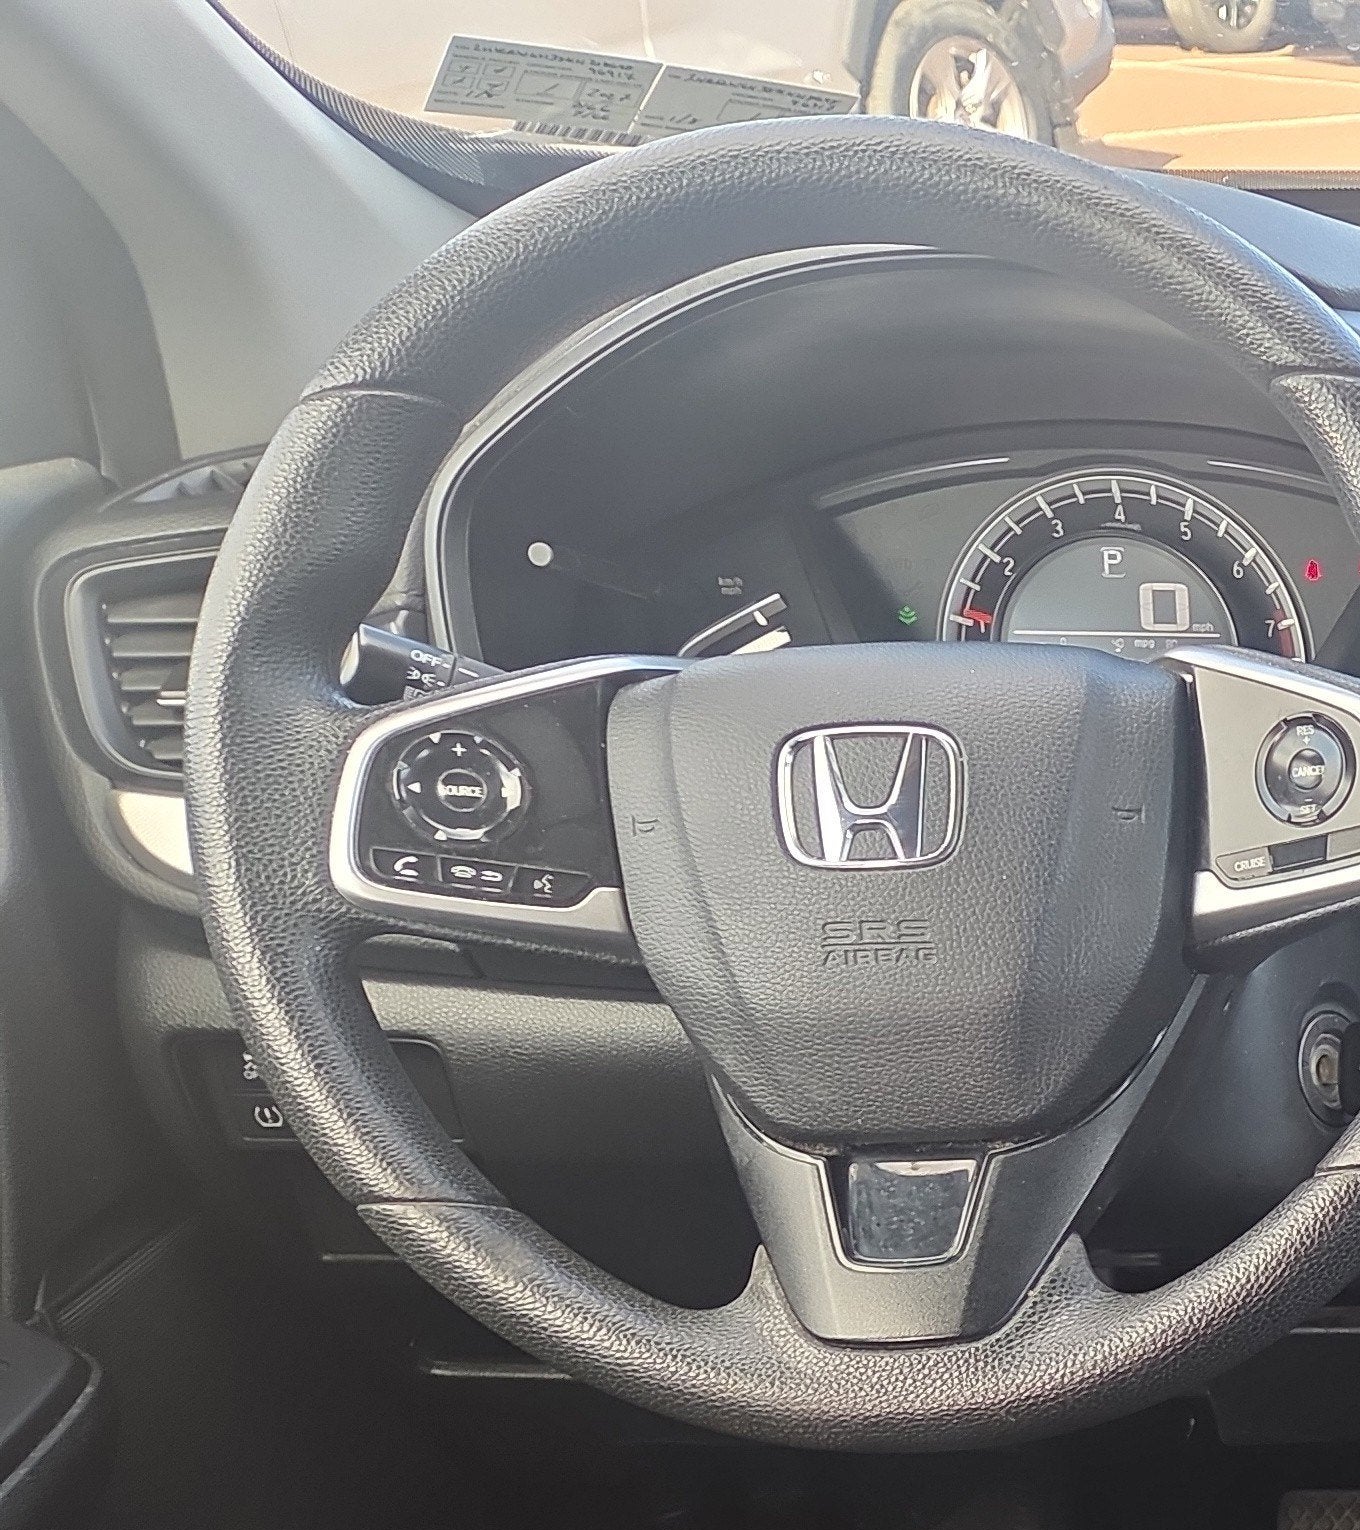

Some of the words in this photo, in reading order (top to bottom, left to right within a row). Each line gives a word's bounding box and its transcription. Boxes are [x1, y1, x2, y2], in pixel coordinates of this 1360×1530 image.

[1051, 518, 1064, 538] 3
[1181, 520, 1192, 541] 5
[1002, 557, 1015, 576] 2
[1232, 561, 1244, 579] 6
[1265, 619, 1275, 638] 7
[411, 649, 442, 666] OFF
[1296, 725, 1315, 736] RES
[1234, 857, 1266, 872] CRUISE
